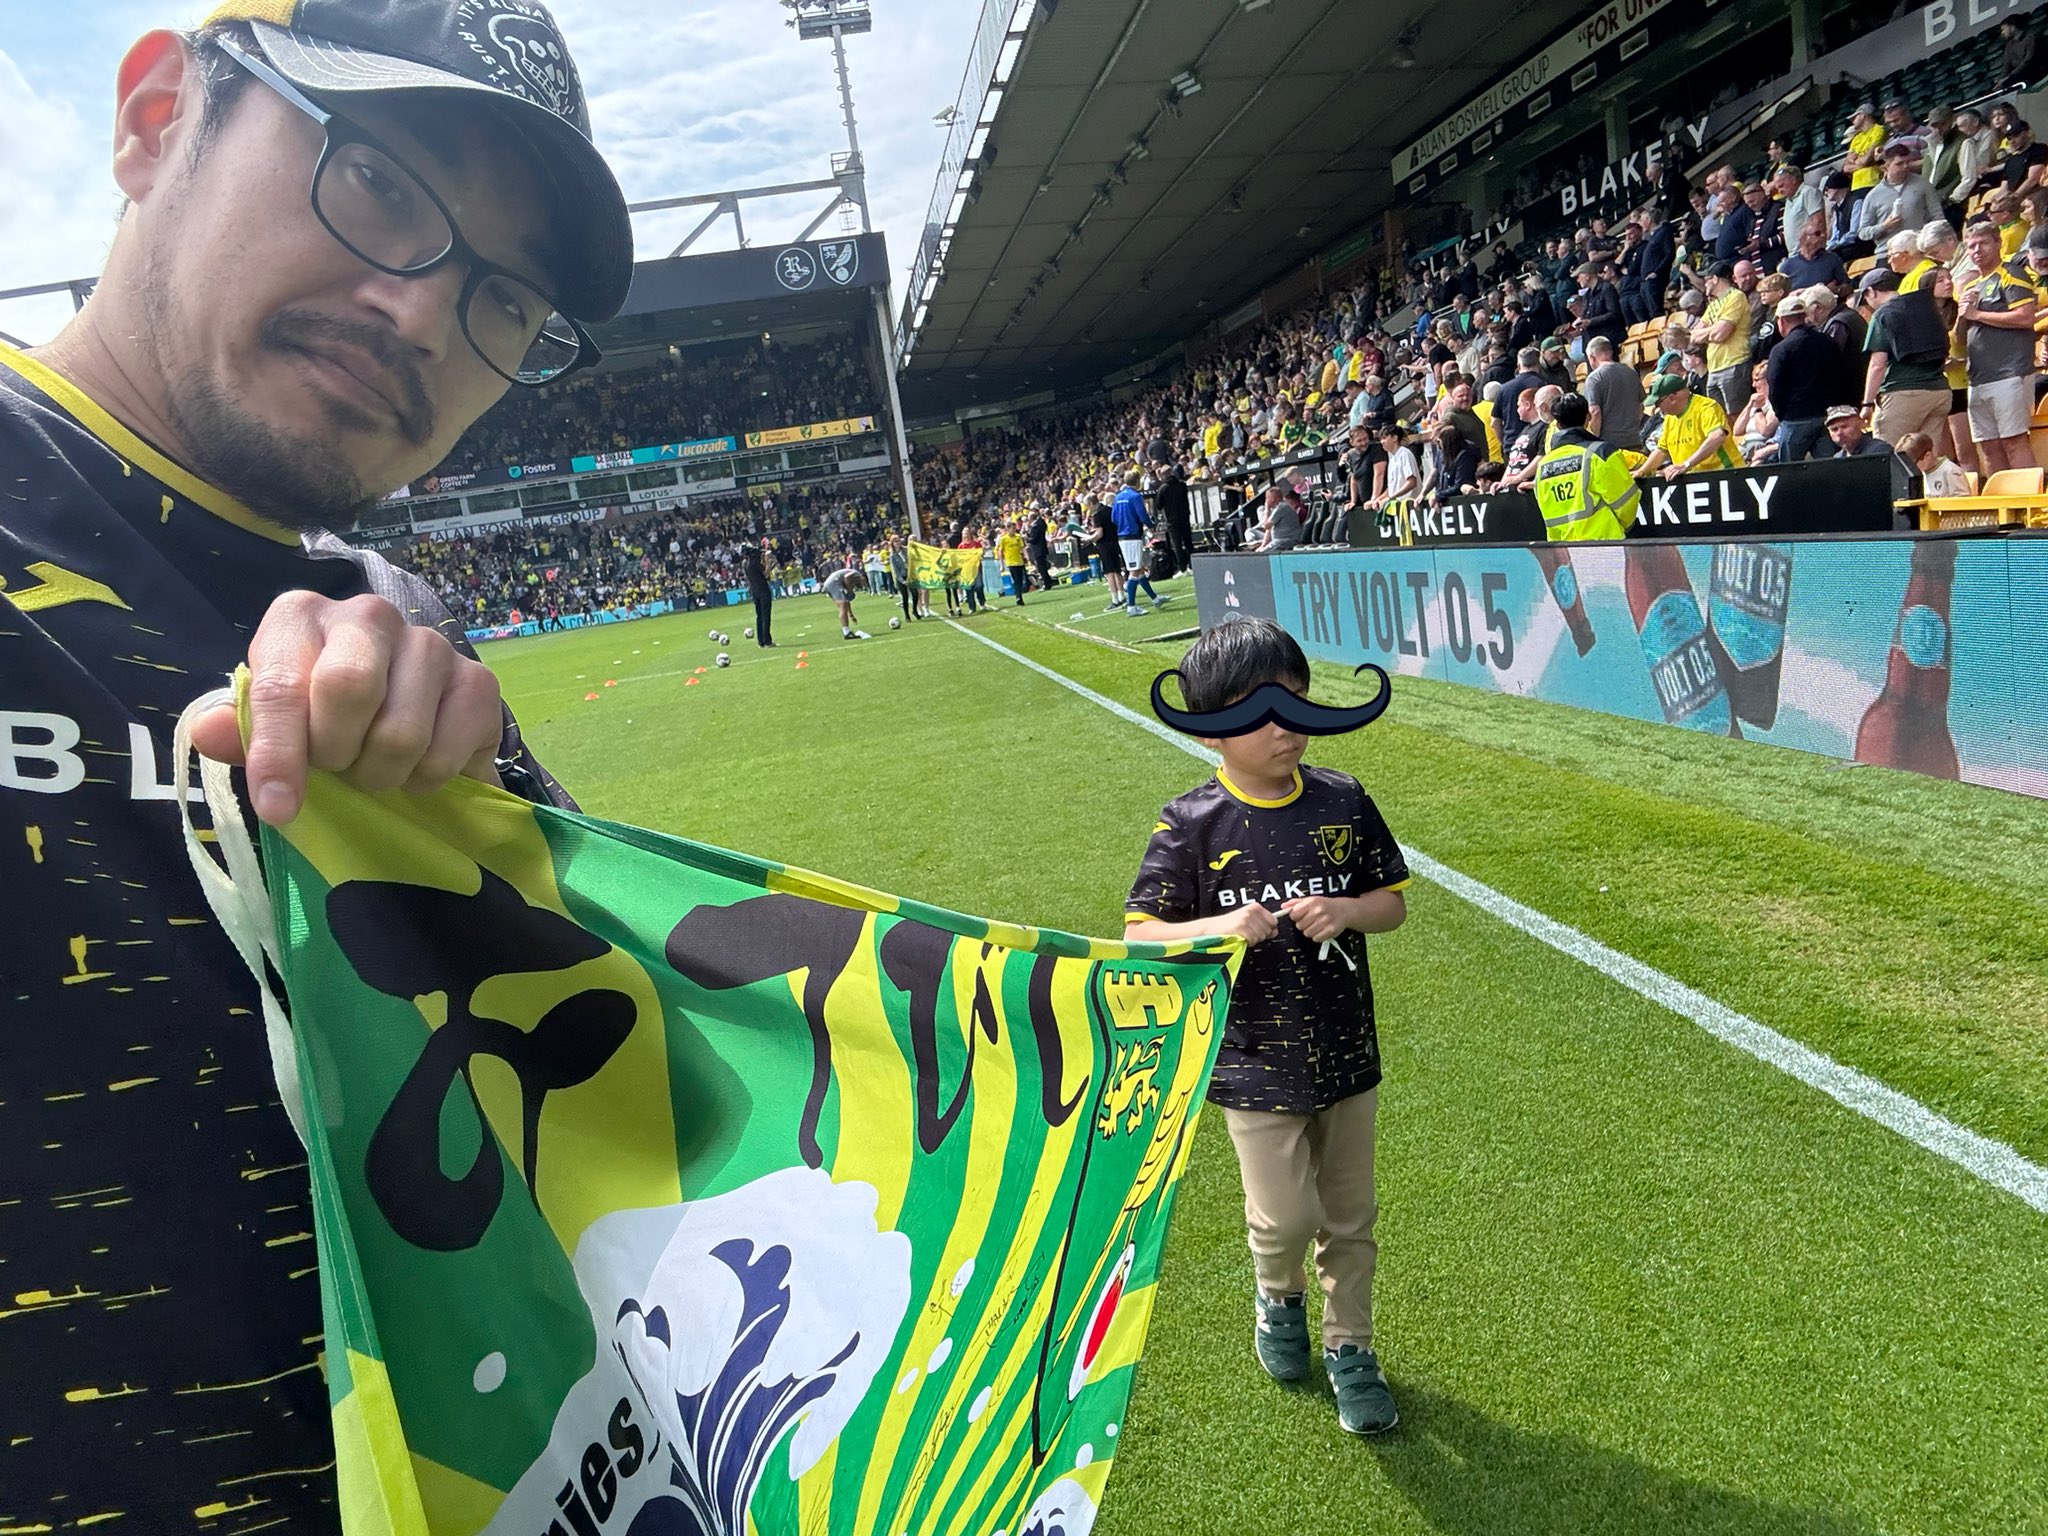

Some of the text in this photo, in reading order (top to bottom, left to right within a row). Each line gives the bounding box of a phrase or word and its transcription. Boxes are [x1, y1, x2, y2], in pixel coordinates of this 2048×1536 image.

[1924, 0, 2019, 47] BL
[1420, 54, 1550, 161] ALAN BOSWELL GROUP
[821, 425, 829, 435] 3
[677, 440, 729, 457] Lucozade
[440, 475, 459, 483] GREEN
[522, 463, 557, 474] Fosters
[638, 490, 670, 500] LOTUS
[1551, 481, 1575, 502] 162
[1636, 475, 1779, 526] KELY
[434, 525, 475, 542] ALAN
[550, 508, 601, 525] GROUP
[1292, 570, 1514, 671] TRY VOLT 0.5
[1655, 654, 1692, 706] VOLT
[1217, 872, 1353, 908] BLAKELY
